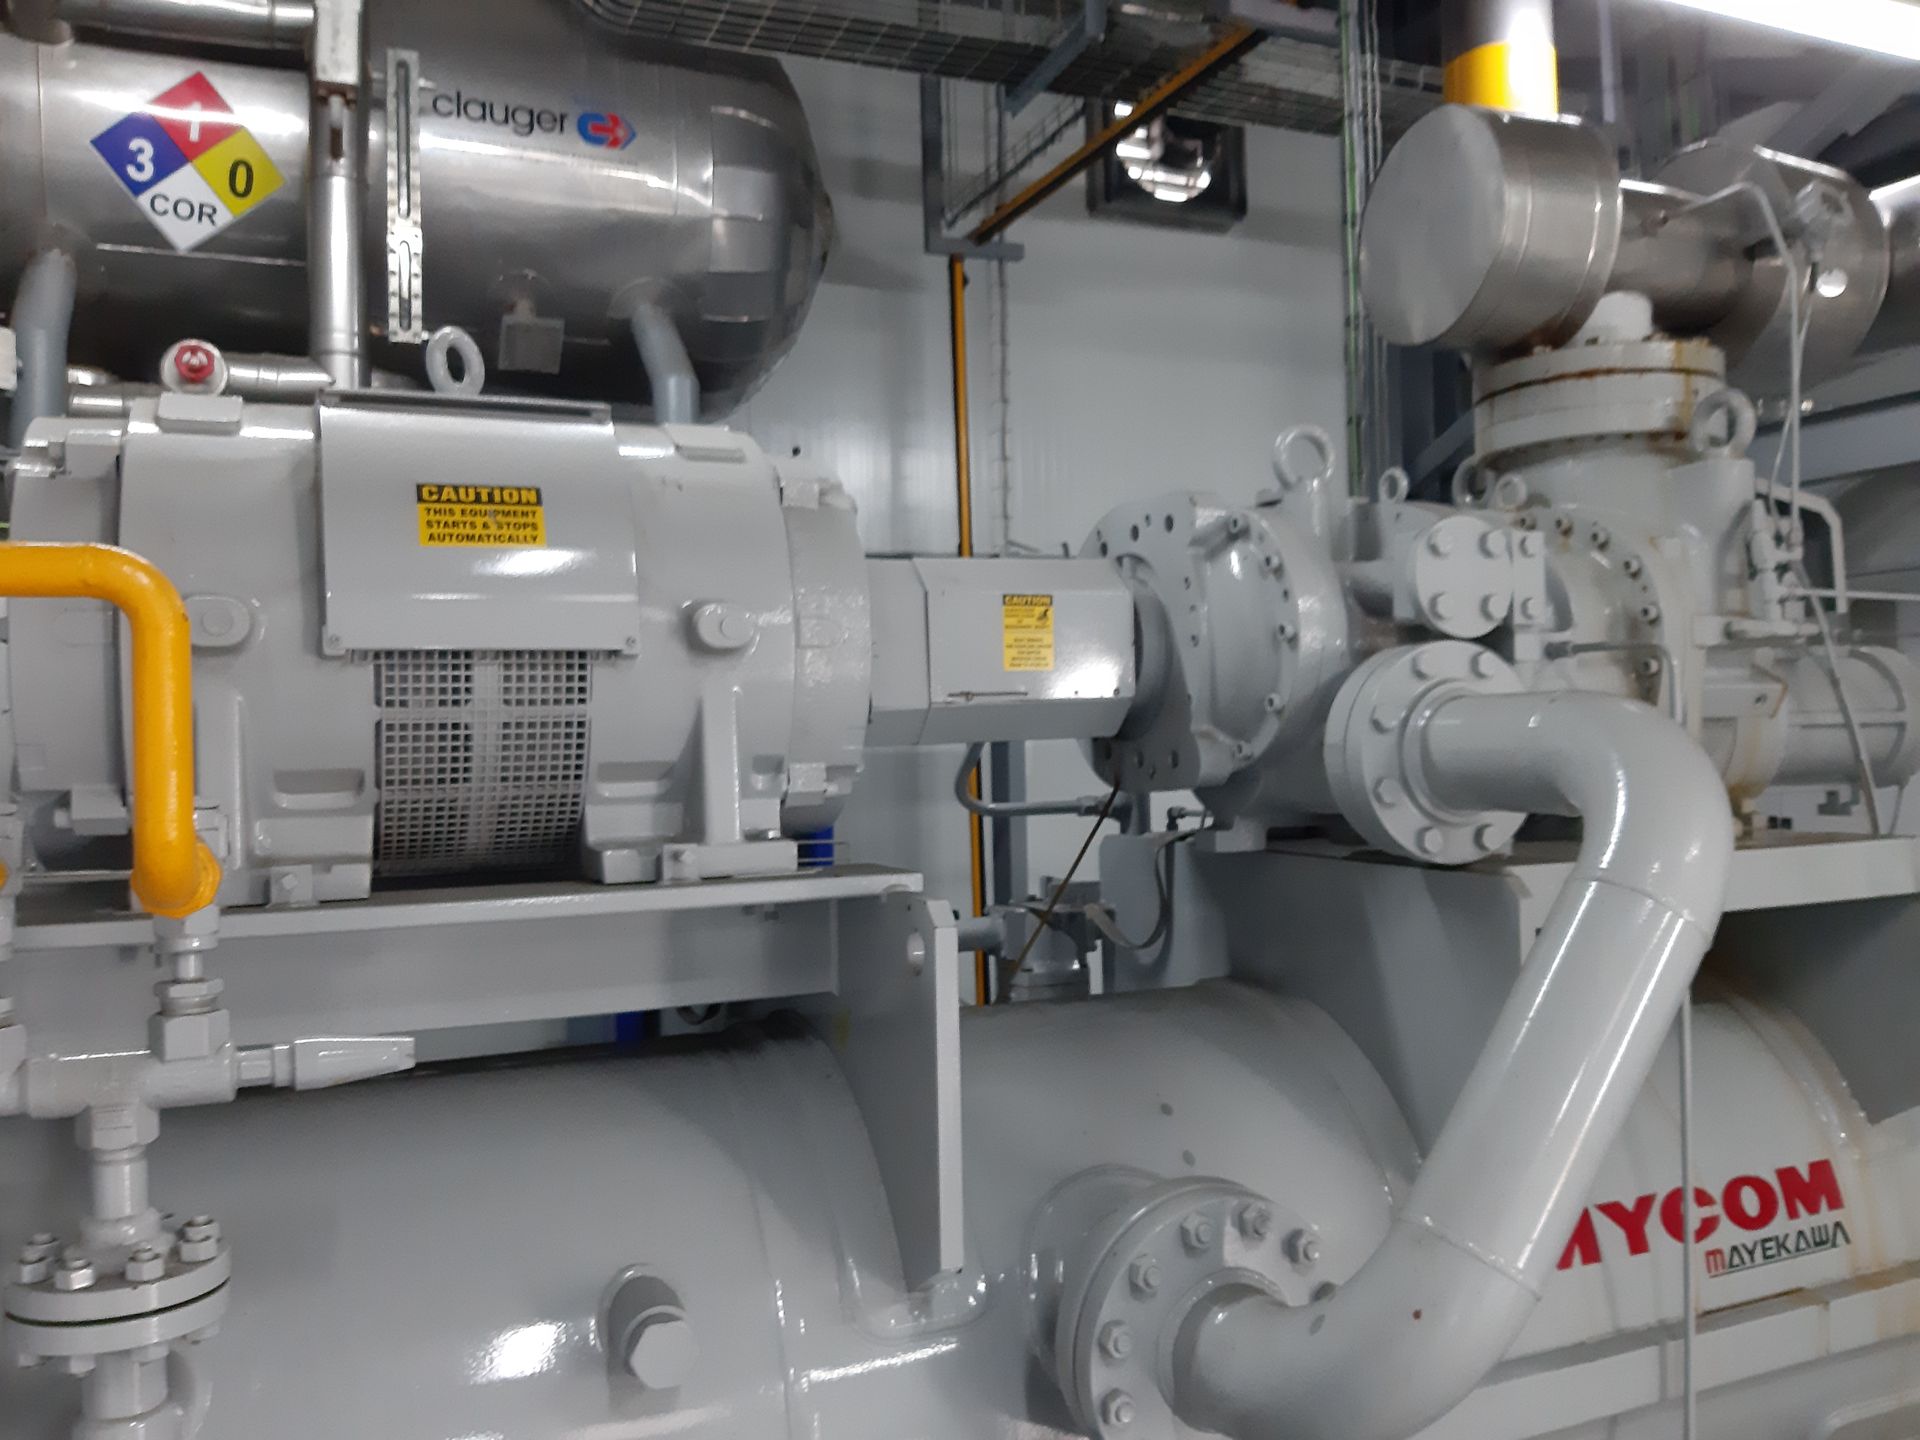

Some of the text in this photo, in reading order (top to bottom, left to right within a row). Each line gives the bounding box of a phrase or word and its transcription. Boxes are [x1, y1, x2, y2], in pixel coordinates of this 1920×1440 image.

[184, 101, 203, 143] 1
[432, 91, 569, 137] clauger
[126, 136, 254, 198] 3 0
[149, 193, 218, 227] COR
[421, 485, 538, 505] CAUTION
[425, 508, 538, 518] THIS EQUPMENT
[426, 520, 478, 530] STARTS
[496, 520, 539, 531] STOPS
[428, 533, 539, 544] AUTOMATICALLY
